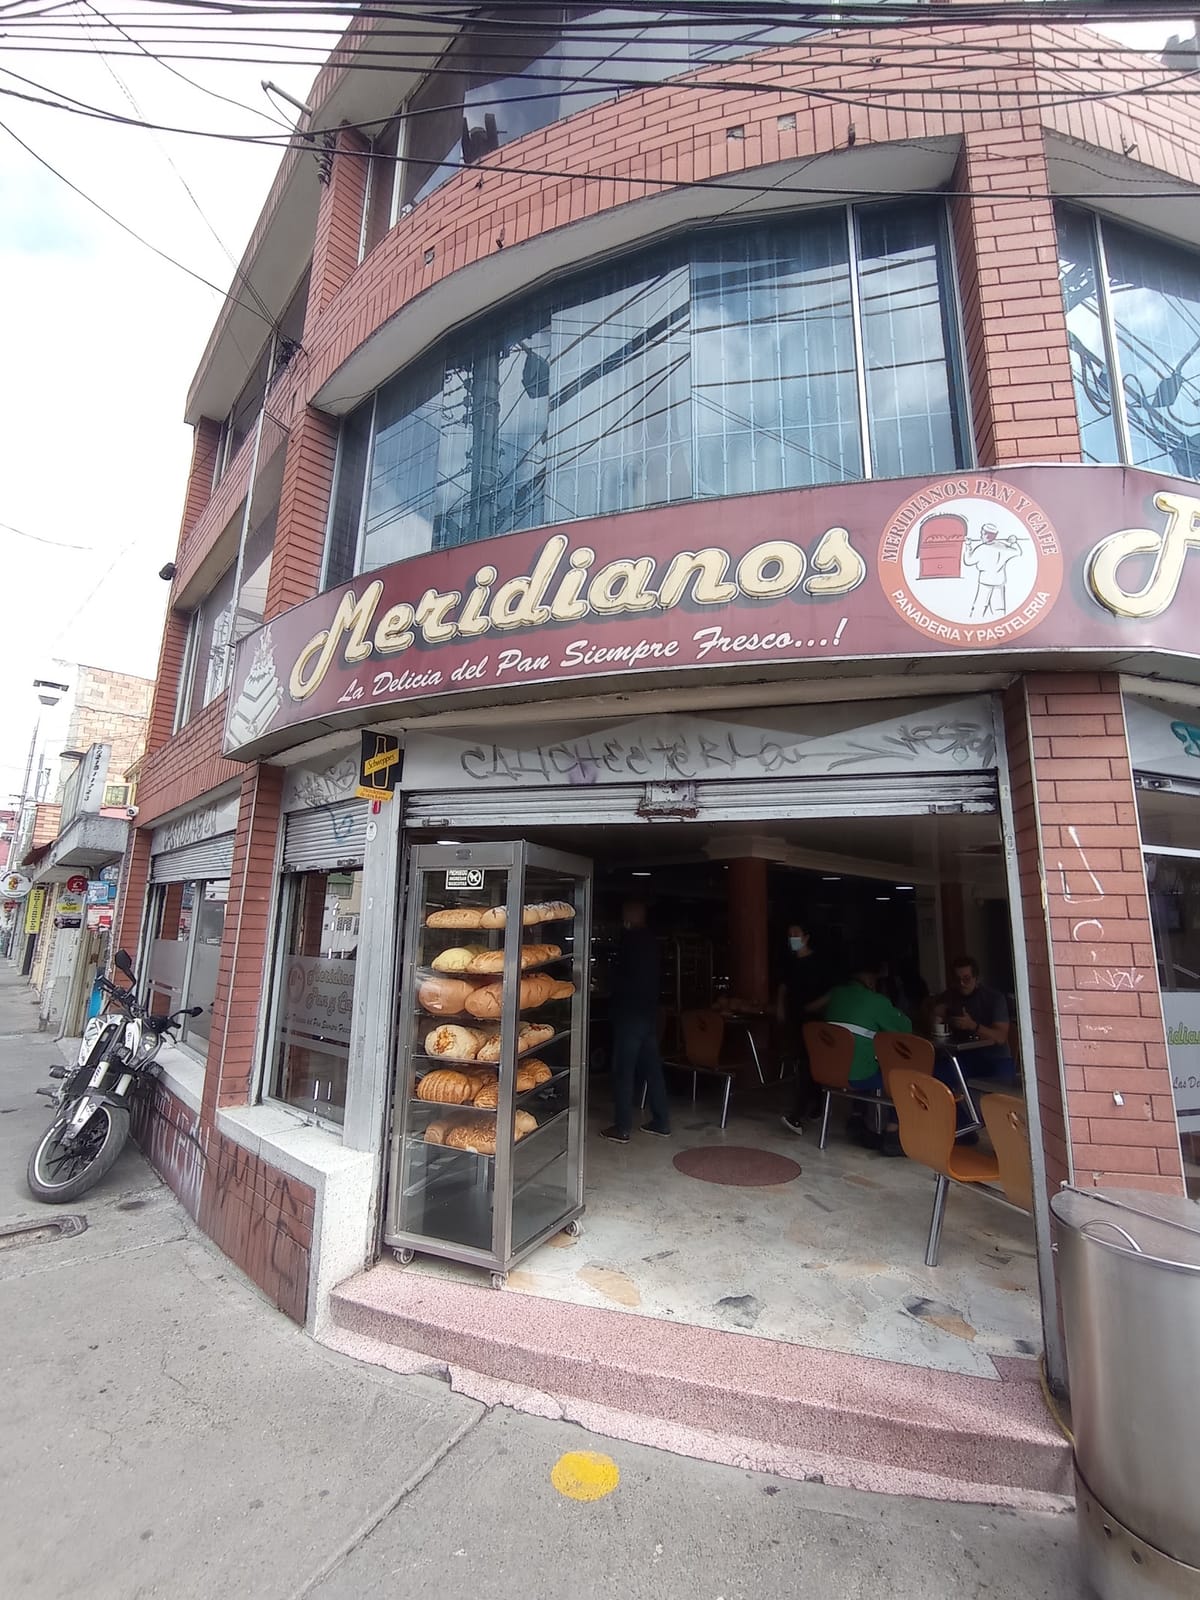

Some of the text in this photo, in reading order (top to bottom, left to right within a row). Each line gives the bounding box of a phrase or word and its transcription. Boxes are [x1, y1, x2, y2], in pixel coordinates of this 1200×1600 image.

[882, 479, 1059, 564] MERIDIANOS PAN Y CAFE
[289, 527, 866, 702] Meridianos
[892, 589, 1051, 642] PANADERIA Y PASTELERIA
[337, 678, 364, 703] La
[372, 669, 443, 696] Delicia
[450, 656, 489, 681] del
[496, 649, 550, 677] Pan
[560, 640, 680, 667] Siempre
